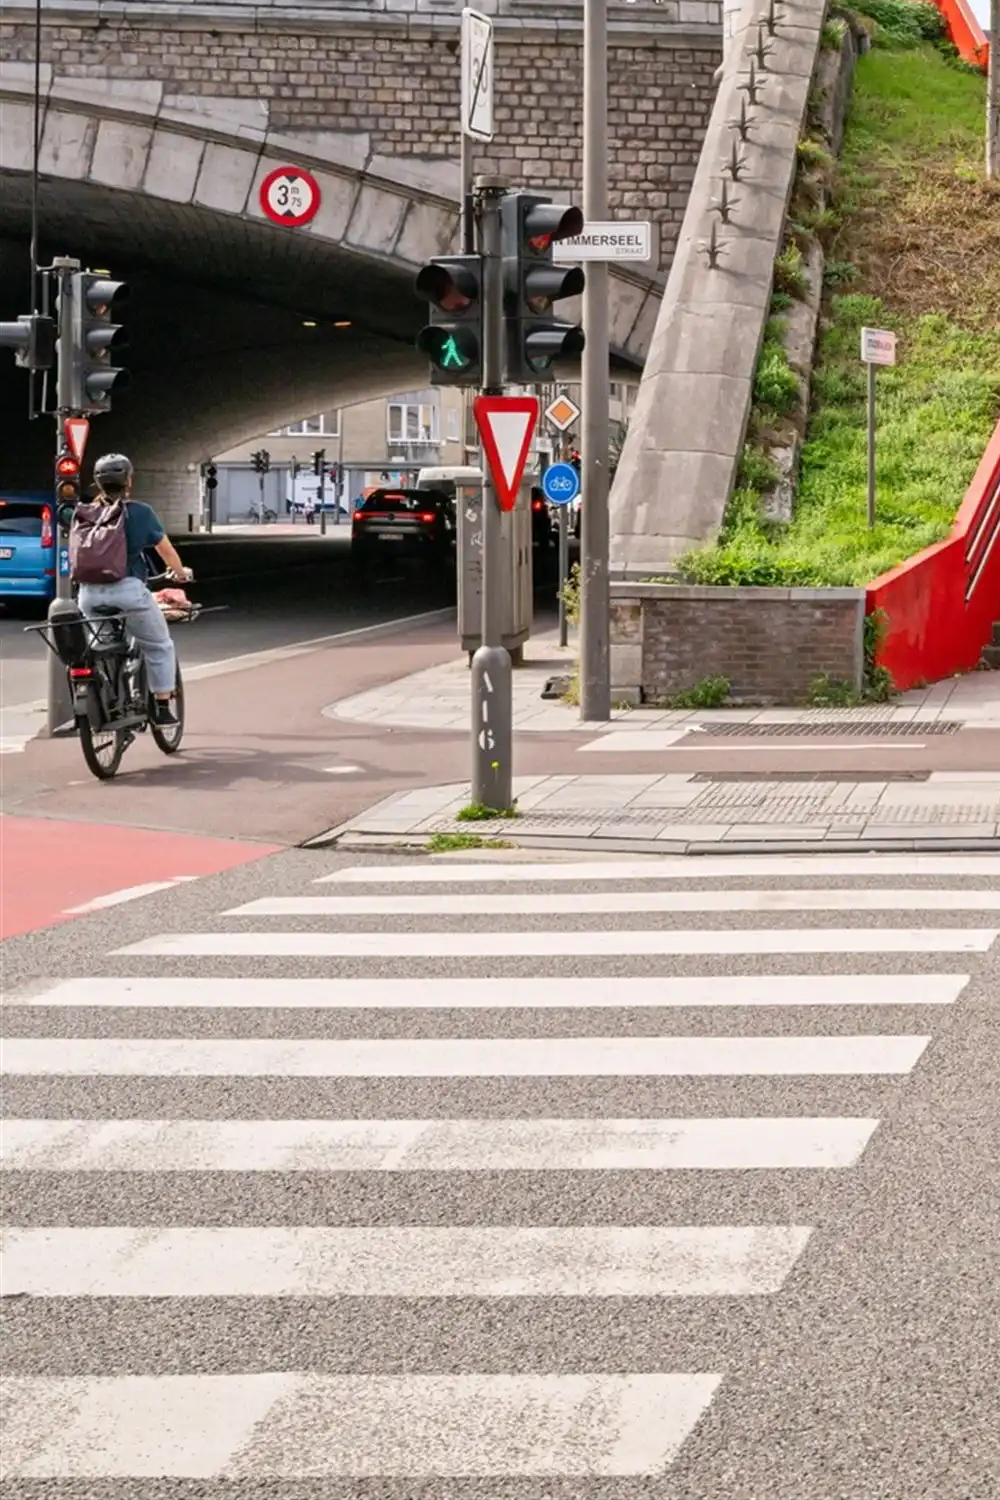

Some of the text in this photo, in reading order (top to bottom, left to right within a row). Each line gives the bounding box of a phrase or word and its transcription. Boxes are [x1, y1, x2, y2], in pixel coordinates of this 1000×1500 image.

[473, 57, 488, 94] 30
[277, 184, 289, 206] 3
[291, 196, 302, 208] 75
[566, 235, 643, 246] IMMERSEEL
